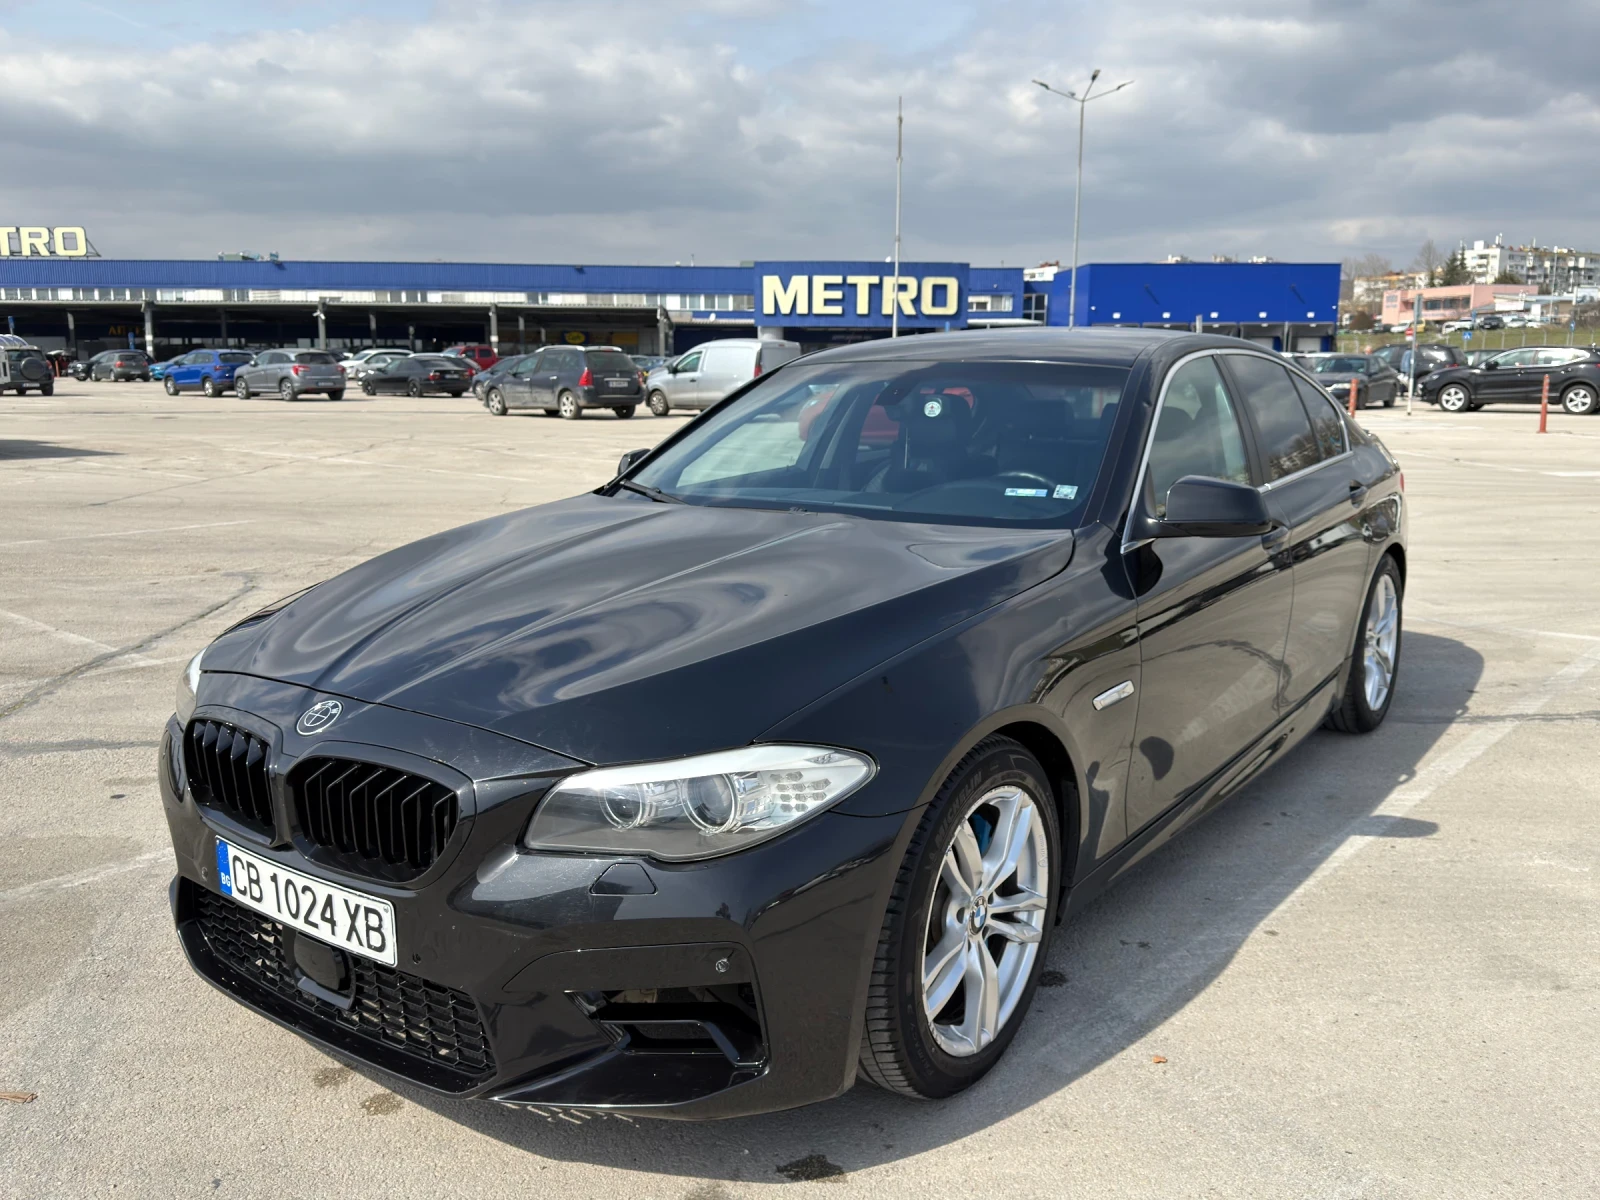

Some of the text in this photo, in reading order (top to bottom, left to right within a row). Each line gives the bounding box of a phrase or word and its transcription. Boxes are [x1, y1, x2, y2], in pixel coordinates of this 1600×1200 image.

[762, 275, 959, 316] METRO
[934, 769, 983, 848] MICHELIN
[221, 872, 231, 887] BG
[232, 854, 387, 953] CB 1024 XB
